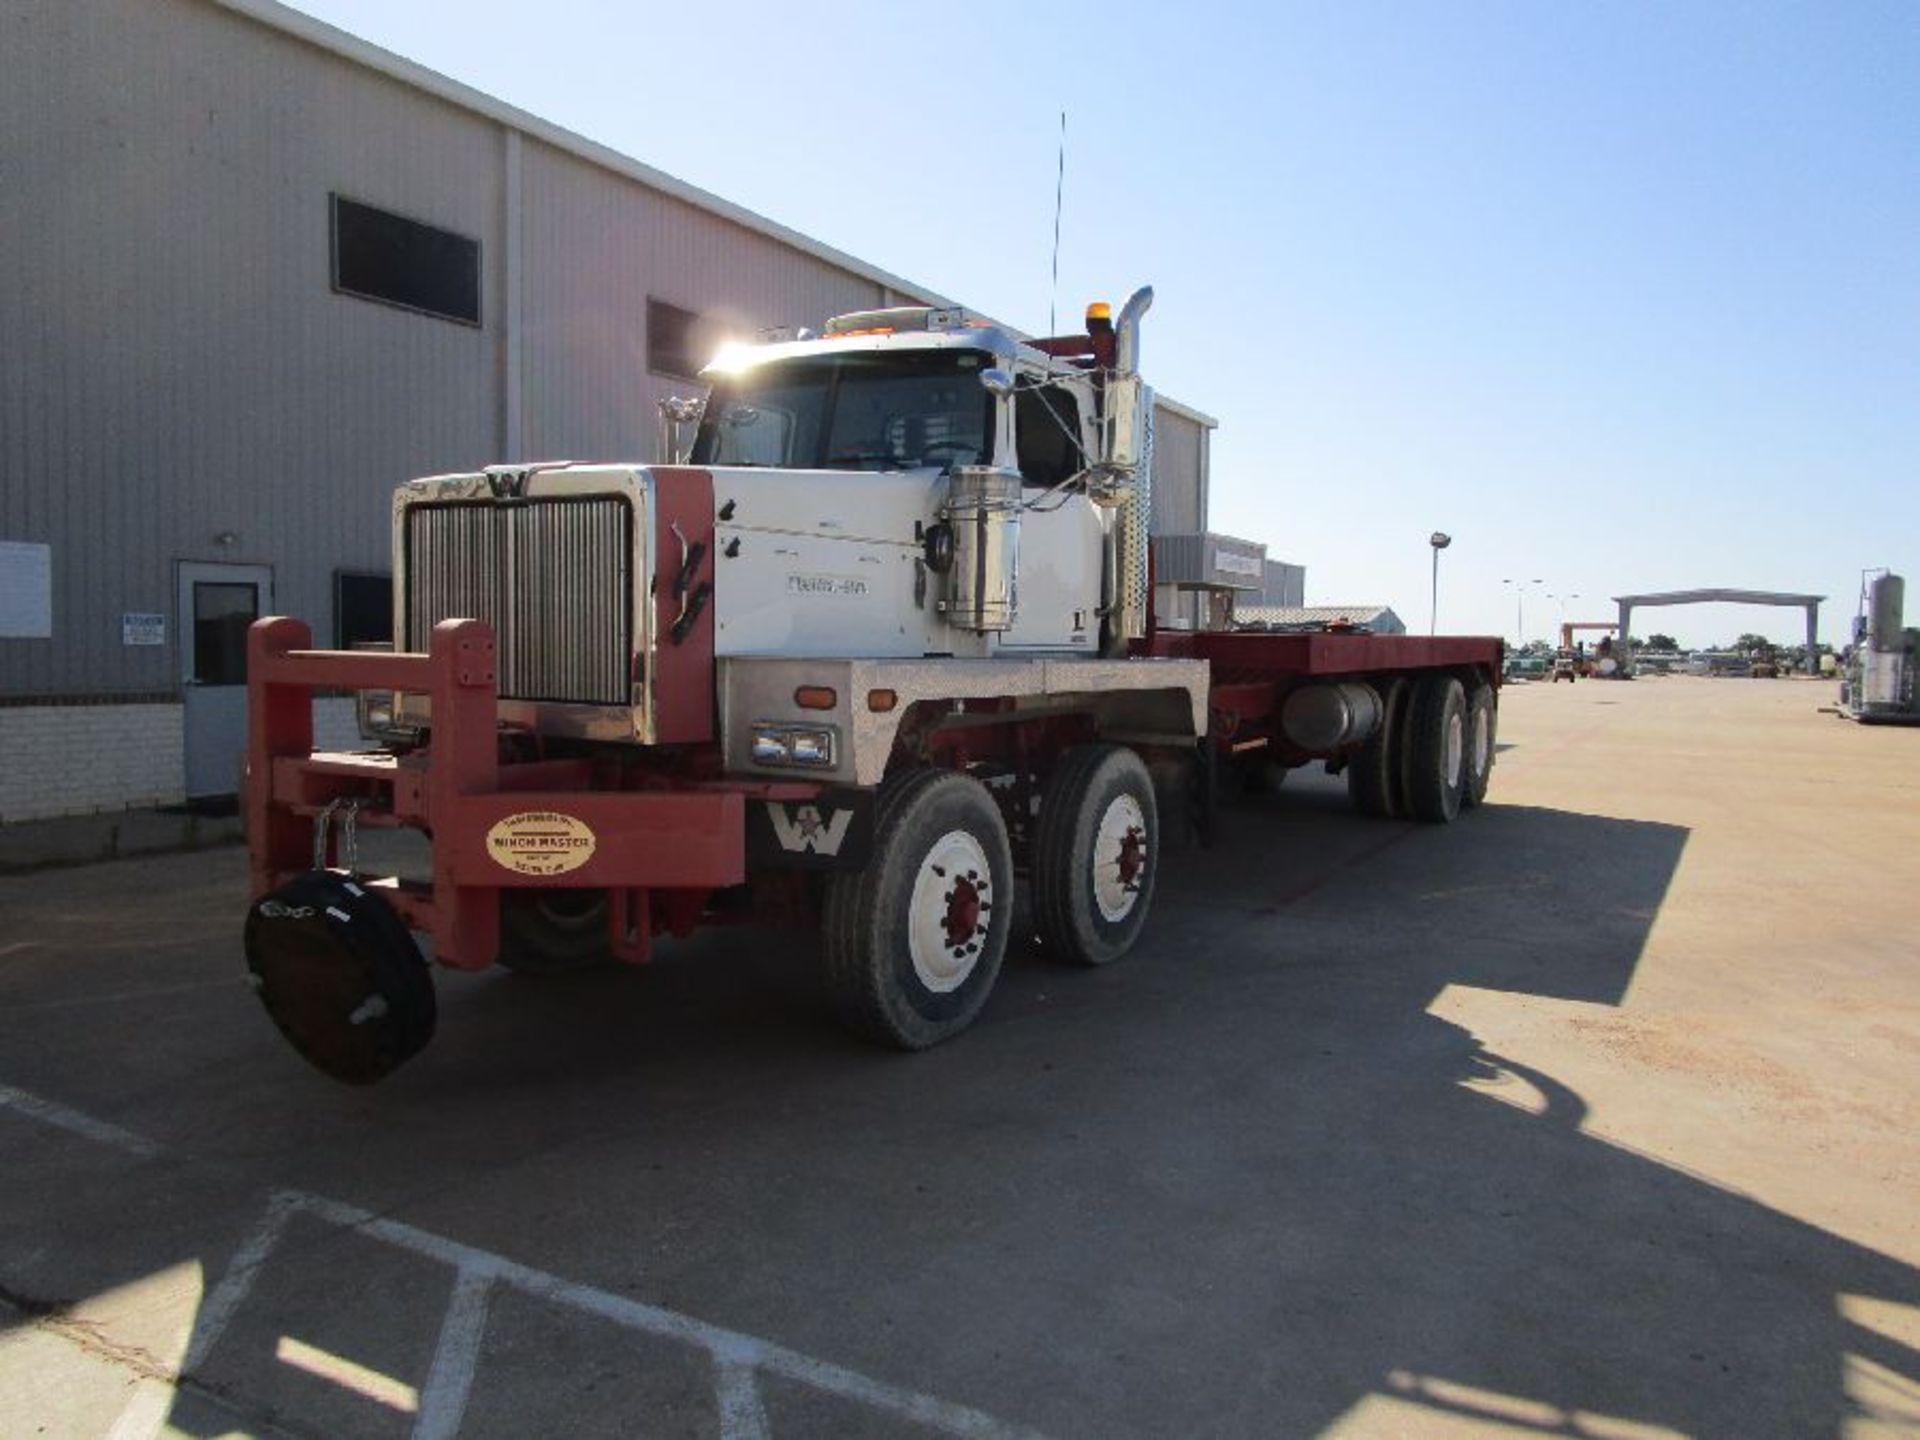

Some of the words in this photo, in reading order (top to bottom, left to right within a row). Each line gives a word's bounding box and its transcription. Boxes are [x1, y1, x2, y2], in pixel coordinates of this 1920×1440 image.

[493, 837, 537, 848] WINCH
[538, 837, 589, 848] MASTER
[766, 801, 854, 857] W
